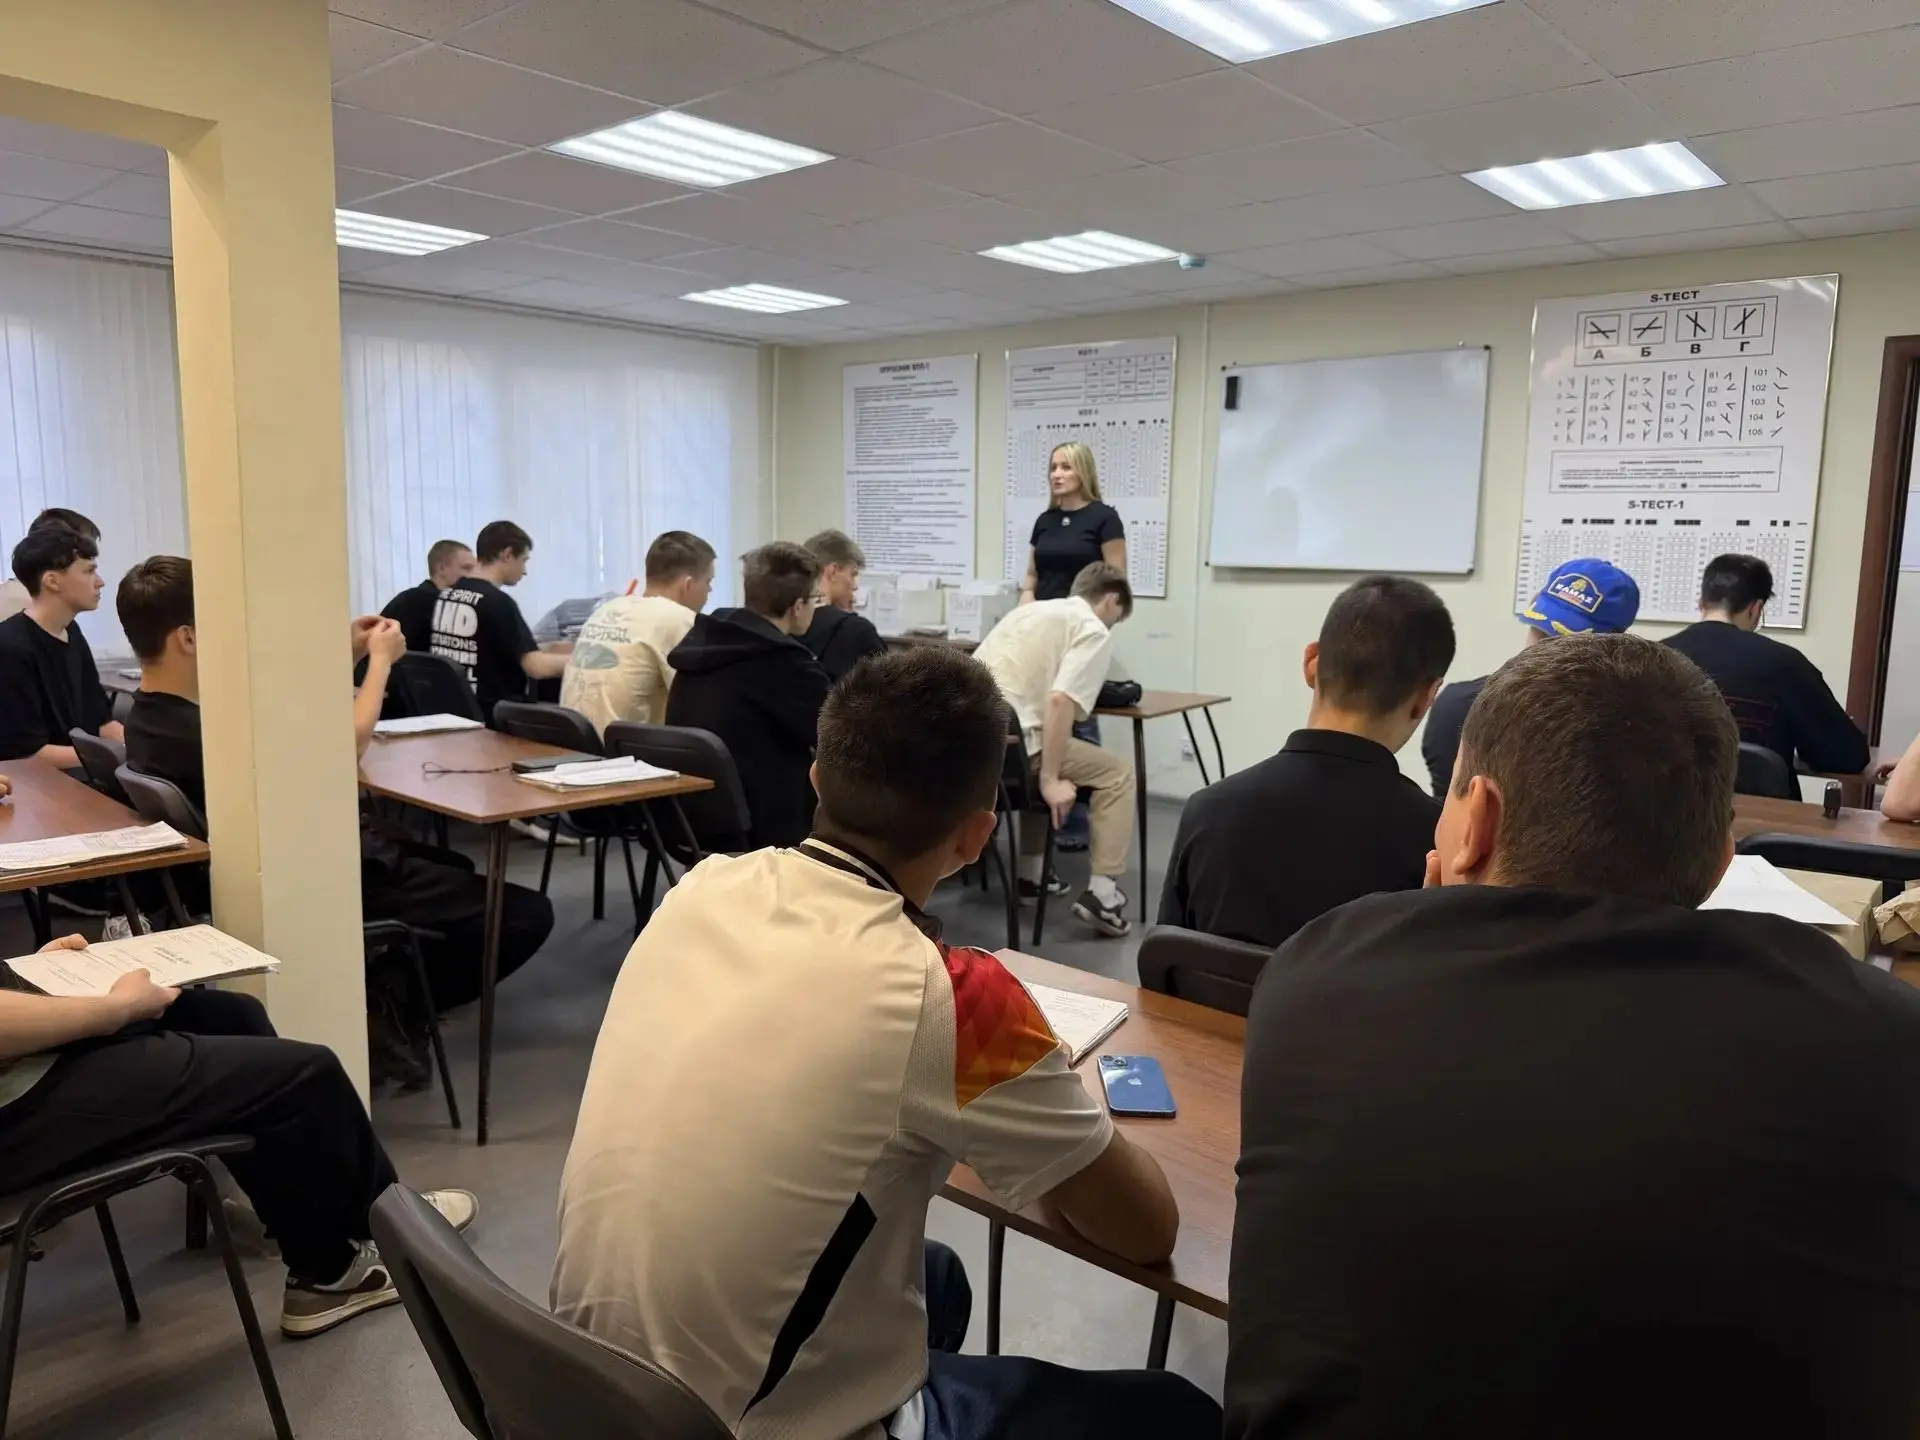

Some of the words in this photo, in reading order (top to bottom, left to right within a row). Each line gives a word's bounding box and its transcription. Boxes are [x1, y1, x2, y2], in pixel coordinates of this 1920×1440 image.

[1649, 290, 1700, 303] S-ТЕСТ
[1593, 349, 1604, 360] А
[1641, 346, 1652, 357] Б
[1690, 343, 1701, 354] В
[1739, 341, 1750, 352] Г
[1751, 398, 1766, 406] 103
[1749, 413, 1764, 421] 104
[1748, 428, 1763, 436] 105
[1628, 499, 1685, 510] S-ТЕСТ-1
[450, 589, 484, 605] SPIRIT
